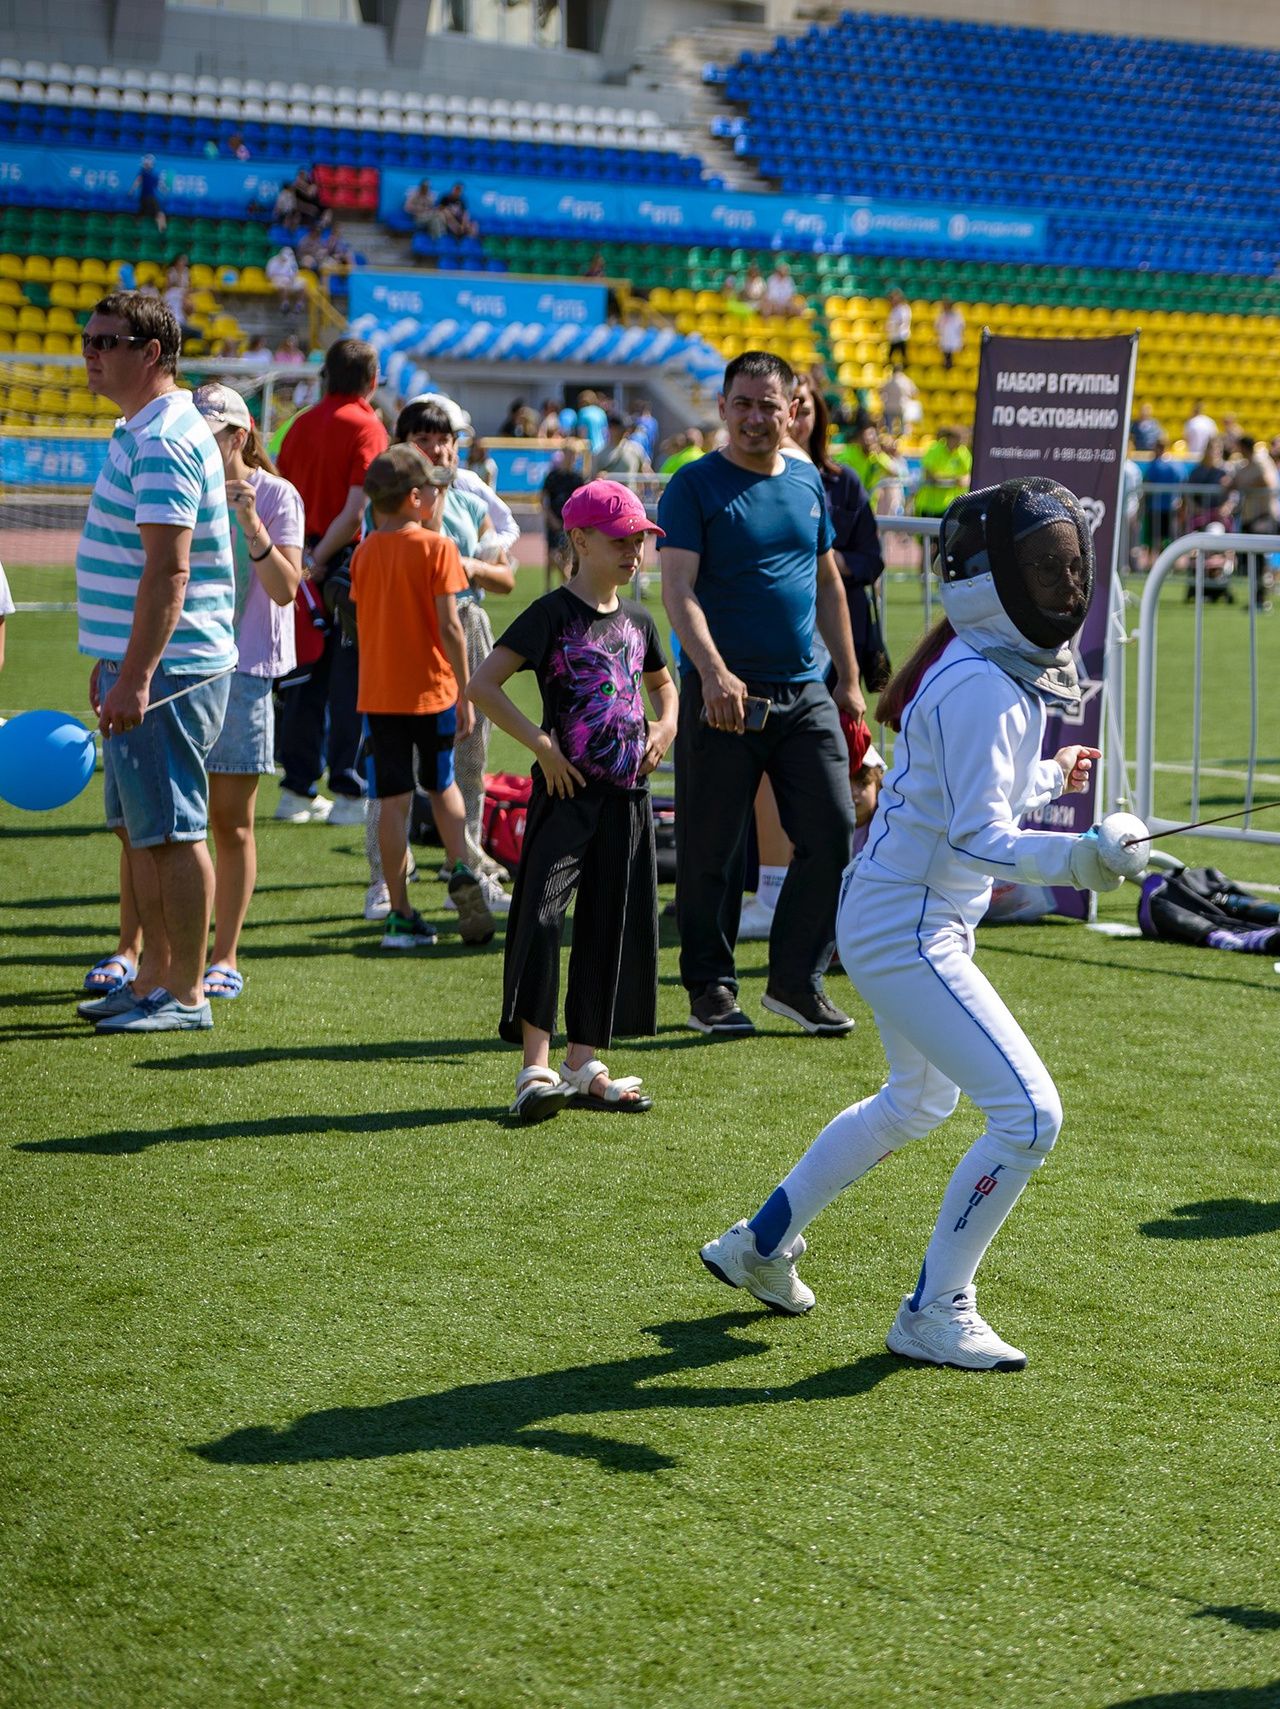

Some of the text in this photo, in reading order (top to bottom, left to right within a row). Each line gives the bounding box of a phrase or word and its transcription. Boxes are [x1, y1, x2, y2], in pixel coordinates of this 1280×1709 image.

[996, 371, 1120, 395] НАБОР В ГРУППЫ
[992, 405, 1119, 430] ПО ФЕХТОВАНИЮ
